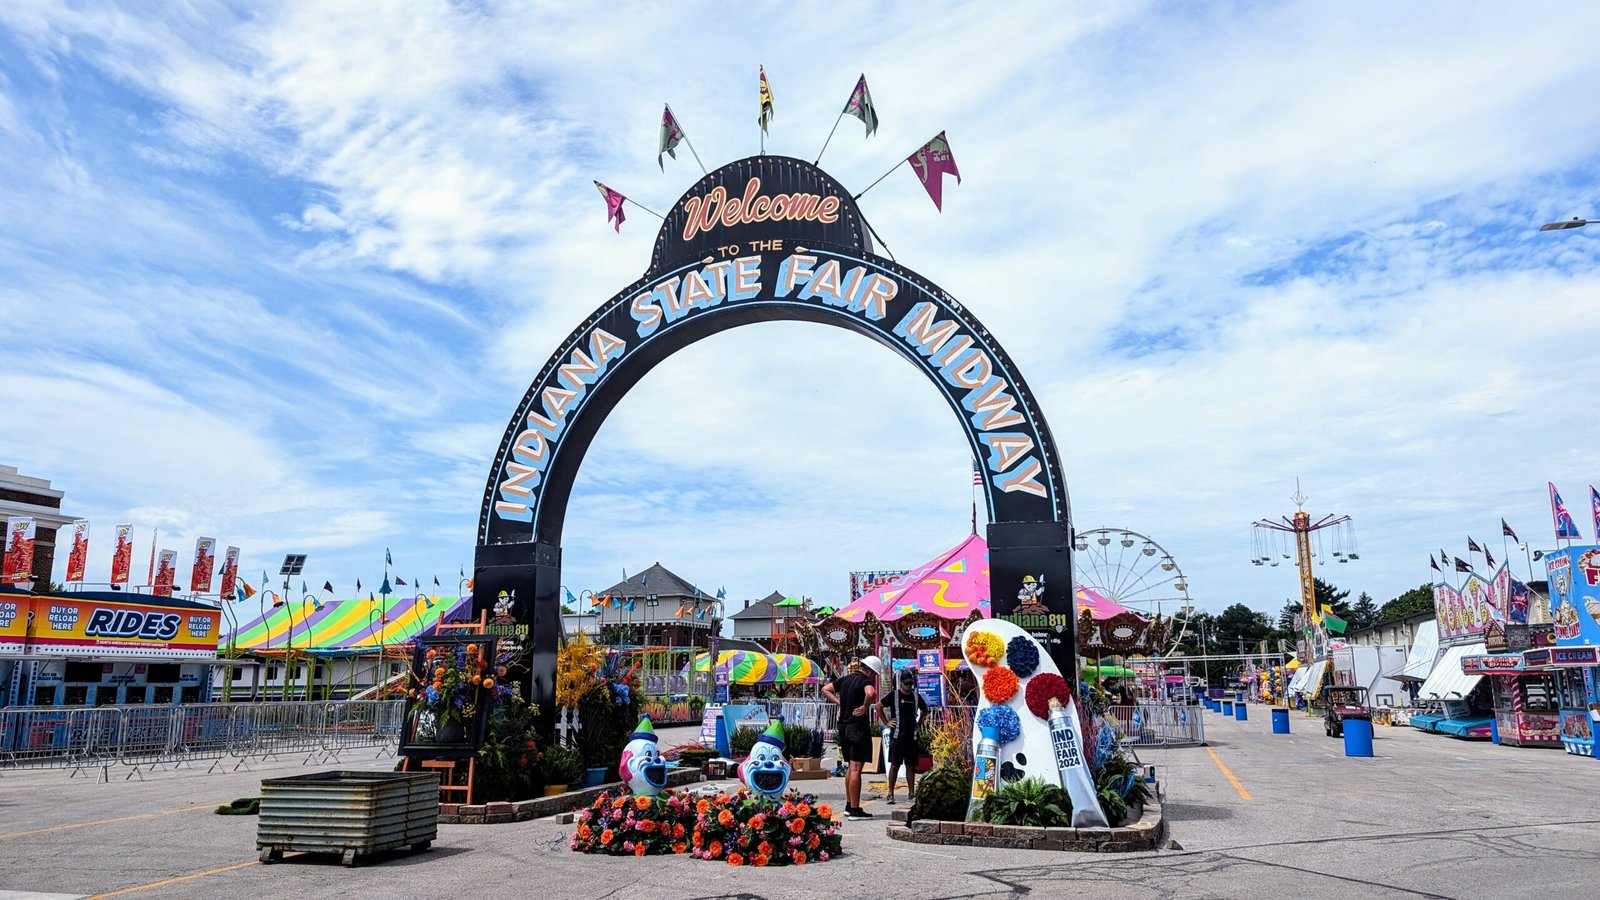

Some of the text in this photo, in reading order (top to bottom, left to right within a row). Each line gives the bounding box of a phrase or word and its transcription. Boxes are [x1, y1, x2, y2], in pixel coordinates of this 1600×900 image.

[682, 176, 840, 241] Welcome
[717, 239, 783, 258] TO THE
[495, 254, 1048, 523] INDIANA STATE FAIR MIDWAY
[0, 611, 16, 619] OAD
[49, 614, 78, 622] RELOAD
[0, 619, 10, 627] RE
[52, 622, 72, 630] HERE
[85, 608, 181, 640] RIDES
[1555, 652, 1567, 660] ICE
[1567, 651, 1593, 660] CREAM
[1053, 729, 1074, 743] IND
[1055, 740, 1076, 750] STATE
[1057, 748, 1078, 759] FAIR
[1059, 757, 1080, 768] 2024
